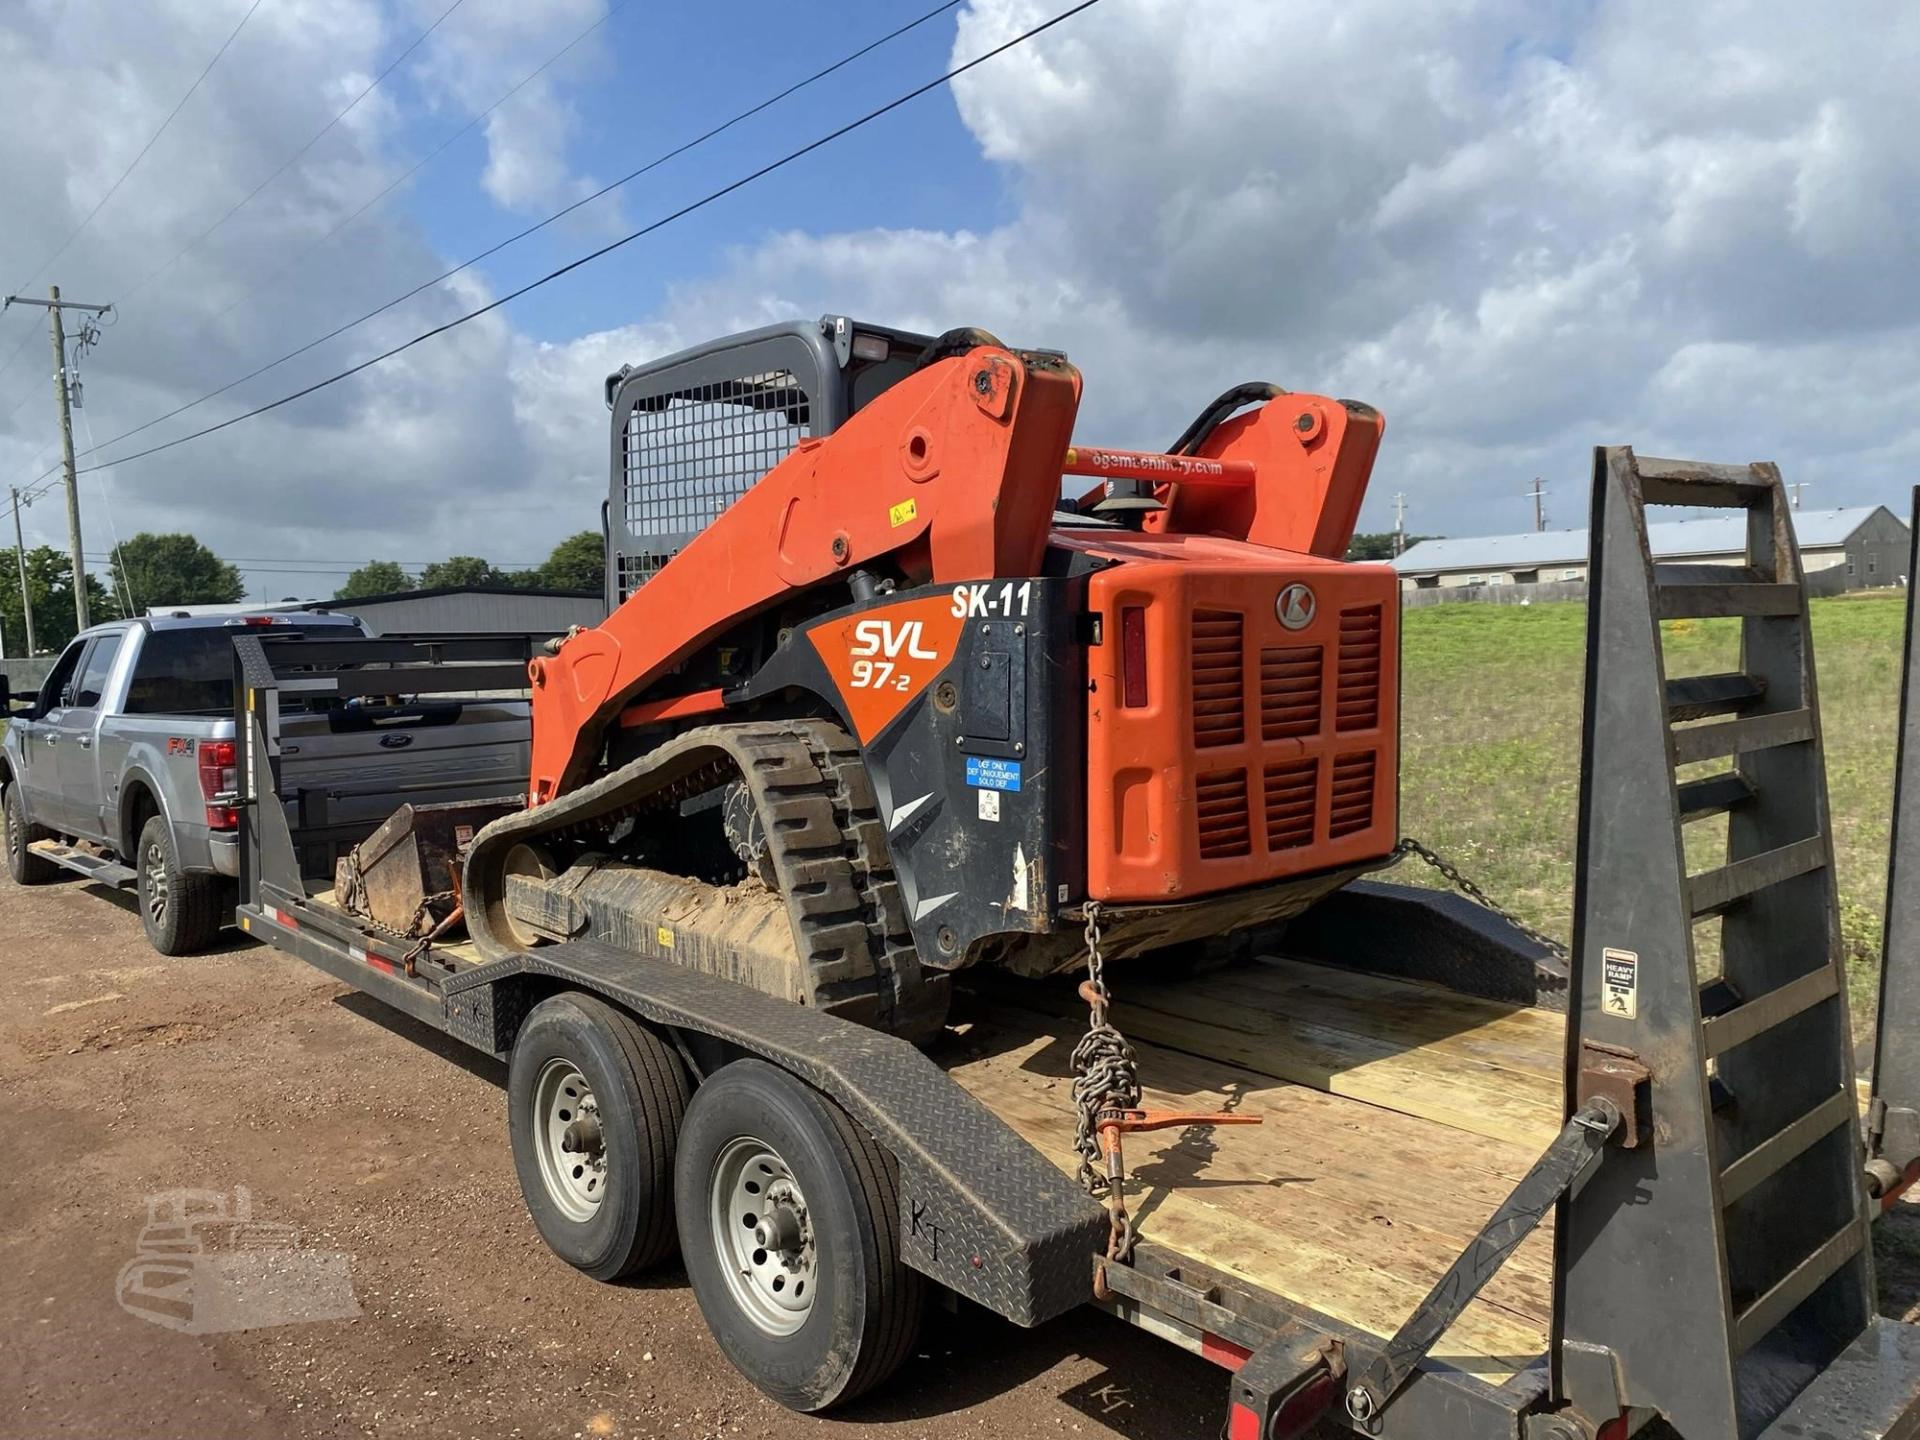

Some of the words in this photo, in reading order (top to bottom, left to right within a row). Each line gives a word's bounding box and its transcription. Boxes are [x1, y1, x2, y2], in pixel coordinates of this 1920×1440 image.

[951, 582, 1031, 618] SK-11
[851, 620, 938, 660] SVL
[851, 661, 911, 691] 97-2
[167, 737, 195, 755] FX4
[1606, 964, 1634, 974] HEAVY
[1608, 970, 1632, 980] RAMP
